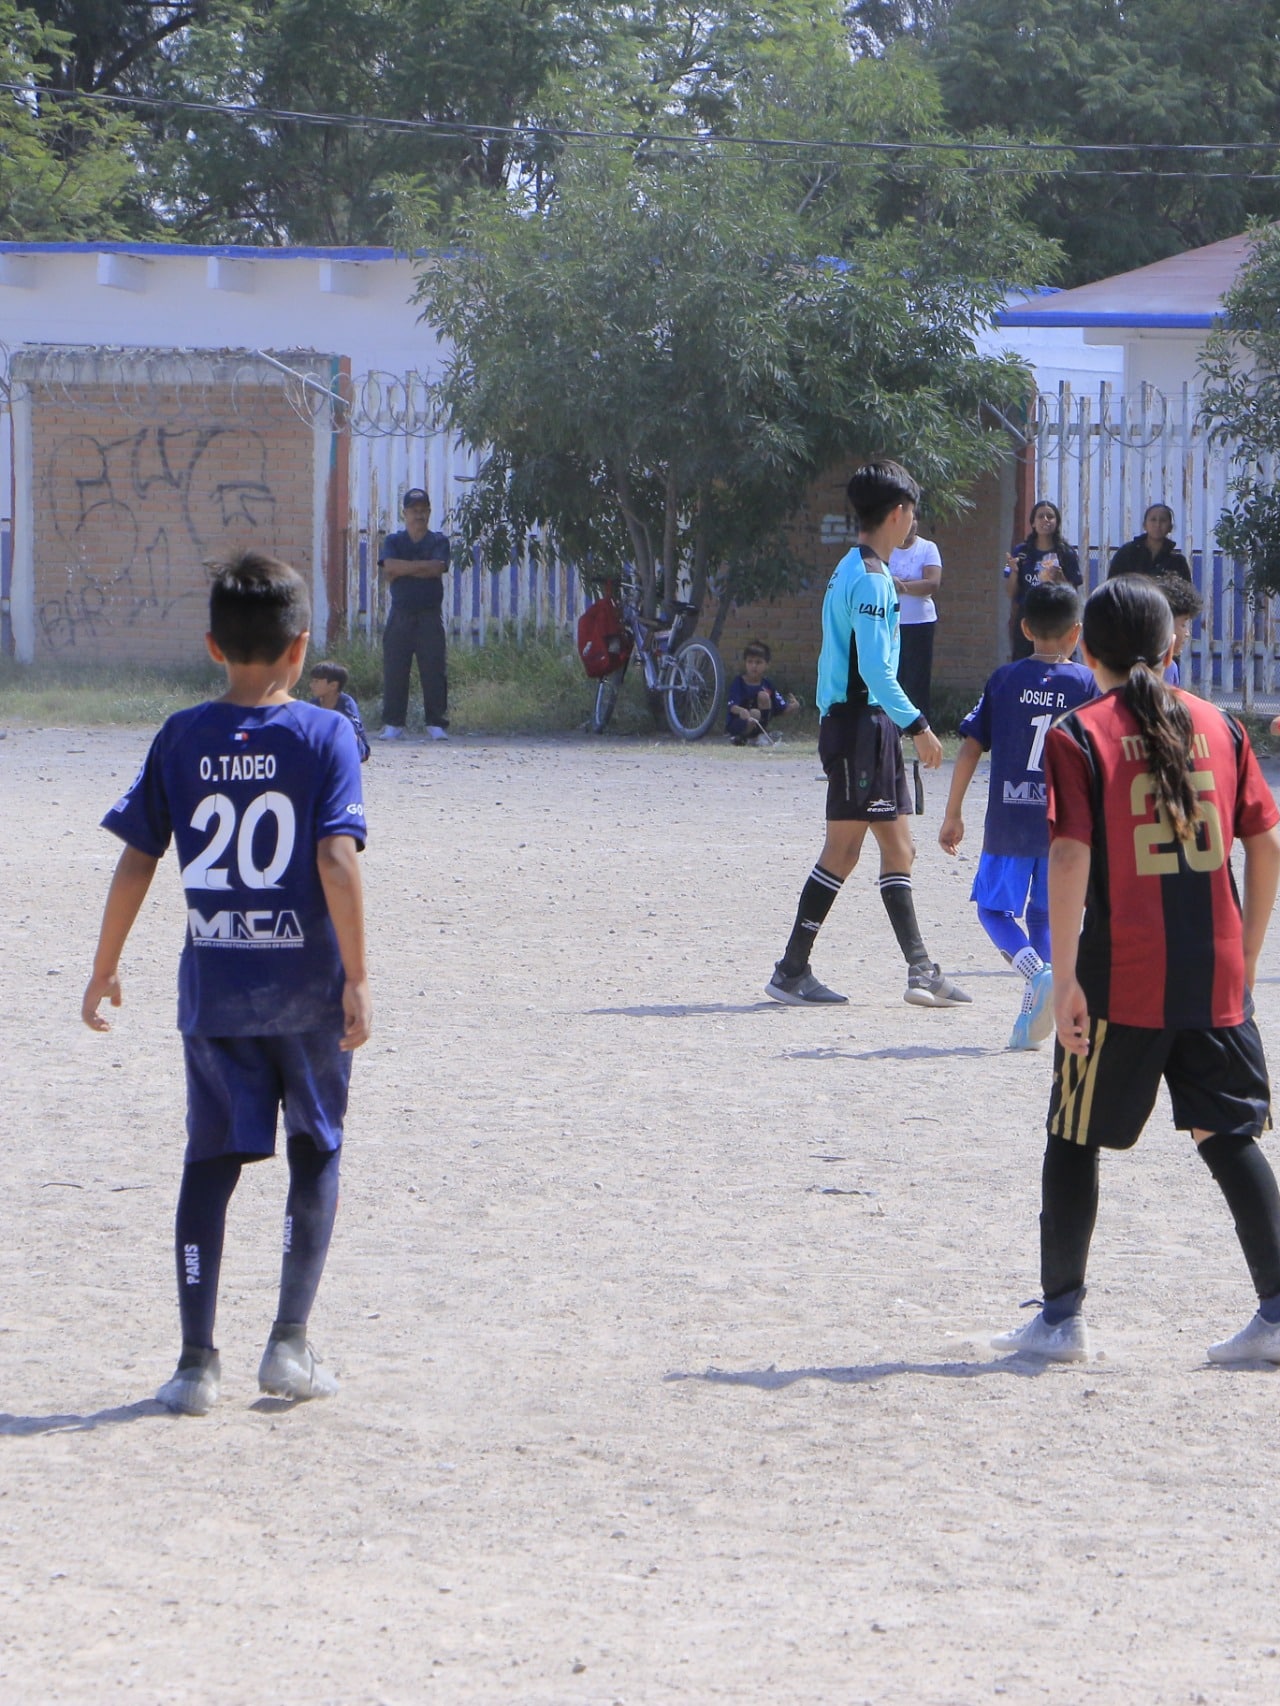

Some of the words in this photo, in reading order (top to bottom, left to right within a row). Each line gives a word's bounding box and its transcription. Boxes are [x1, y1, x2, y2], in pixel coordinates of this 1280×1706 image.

[1019, 688, 1054, 707] JOSUE
[1056, 692, 1068, 709] R.
[199, 754, 277, 782] O.TADEO
[181, 790, 296, 891] 20
[184, 1243, 201, 1286] PARIS
